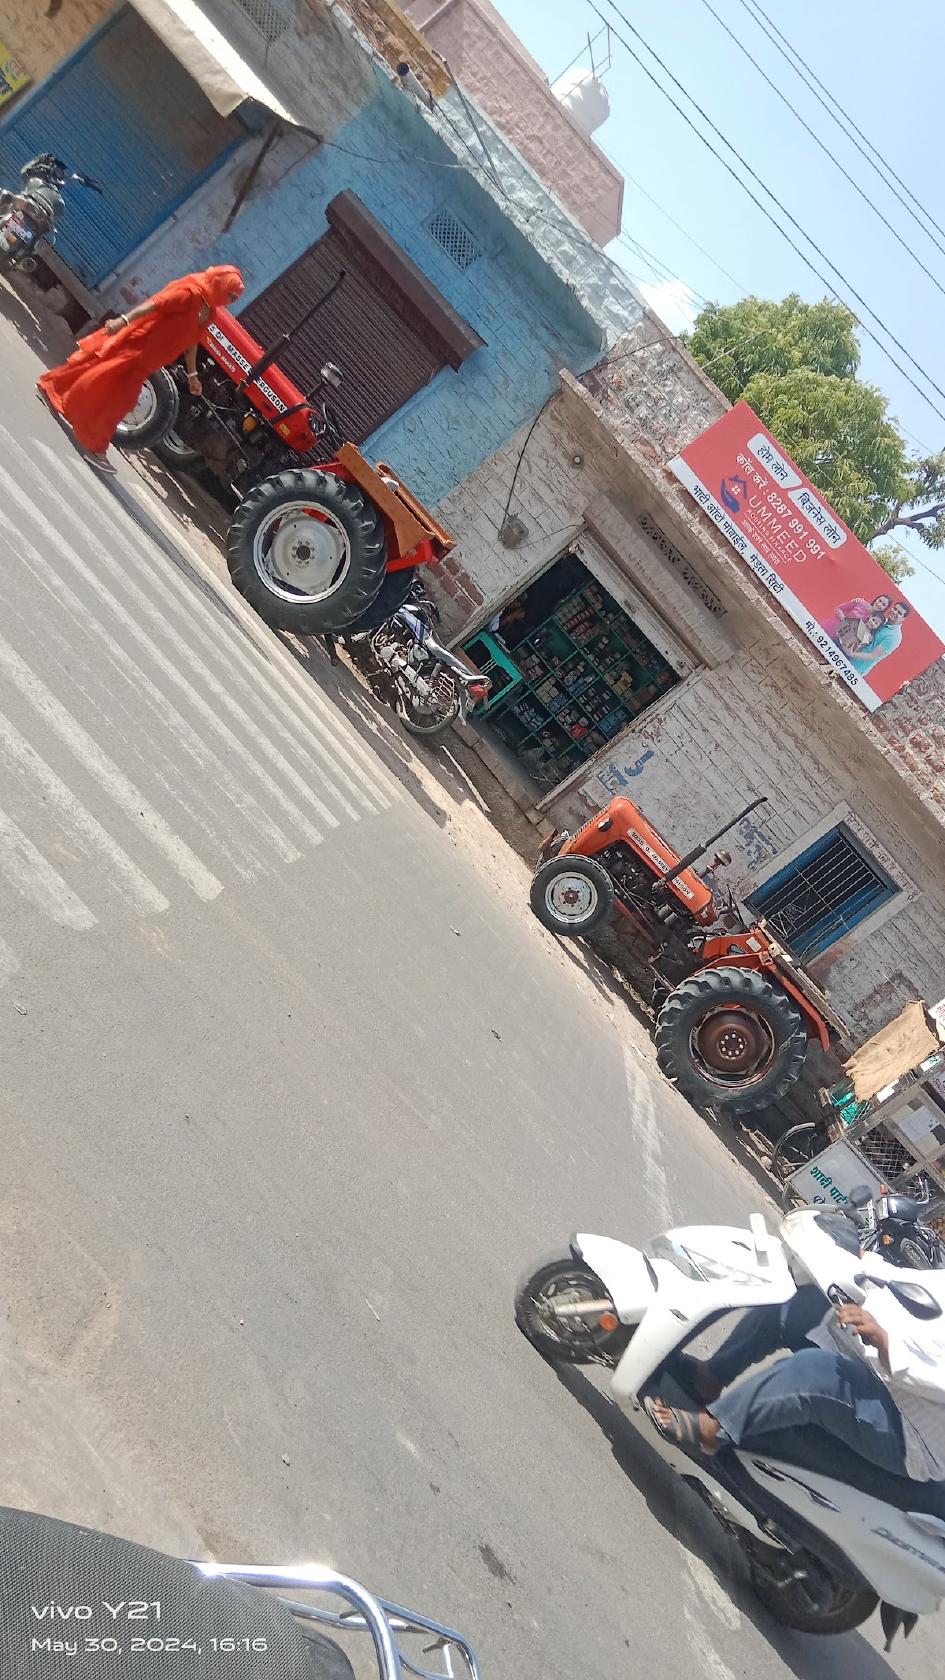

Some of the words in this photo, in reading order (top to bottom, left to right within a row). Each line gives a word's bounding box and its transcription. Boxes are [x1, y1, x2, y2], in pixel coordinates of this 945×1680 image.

[226, 344, 252, 375] MASSE
[256, 378, 285, 411] ERGUSON
[757, 445, 774, 463] होम
[771, 461, 788, 481] लोन
[736, 453, 754, 475] कॉल
[767, 492, 792, 518] 8287
[789, 518, 809, 540] 991
[806, 539, 826, 560] 991
[749, 495, 807, 563] UMMEED
[693, 484, 711, 505] भाटी
[707, 503, 725, 523] ऑटो
[765, 573, 785, 594] सिटी
[768, 535, 792, 562] FINANCE
[823, 523, 841, 544] लोन
[816, 635, 858, 686] 9214967485
[811, 1166, 832, 1188] शादी
